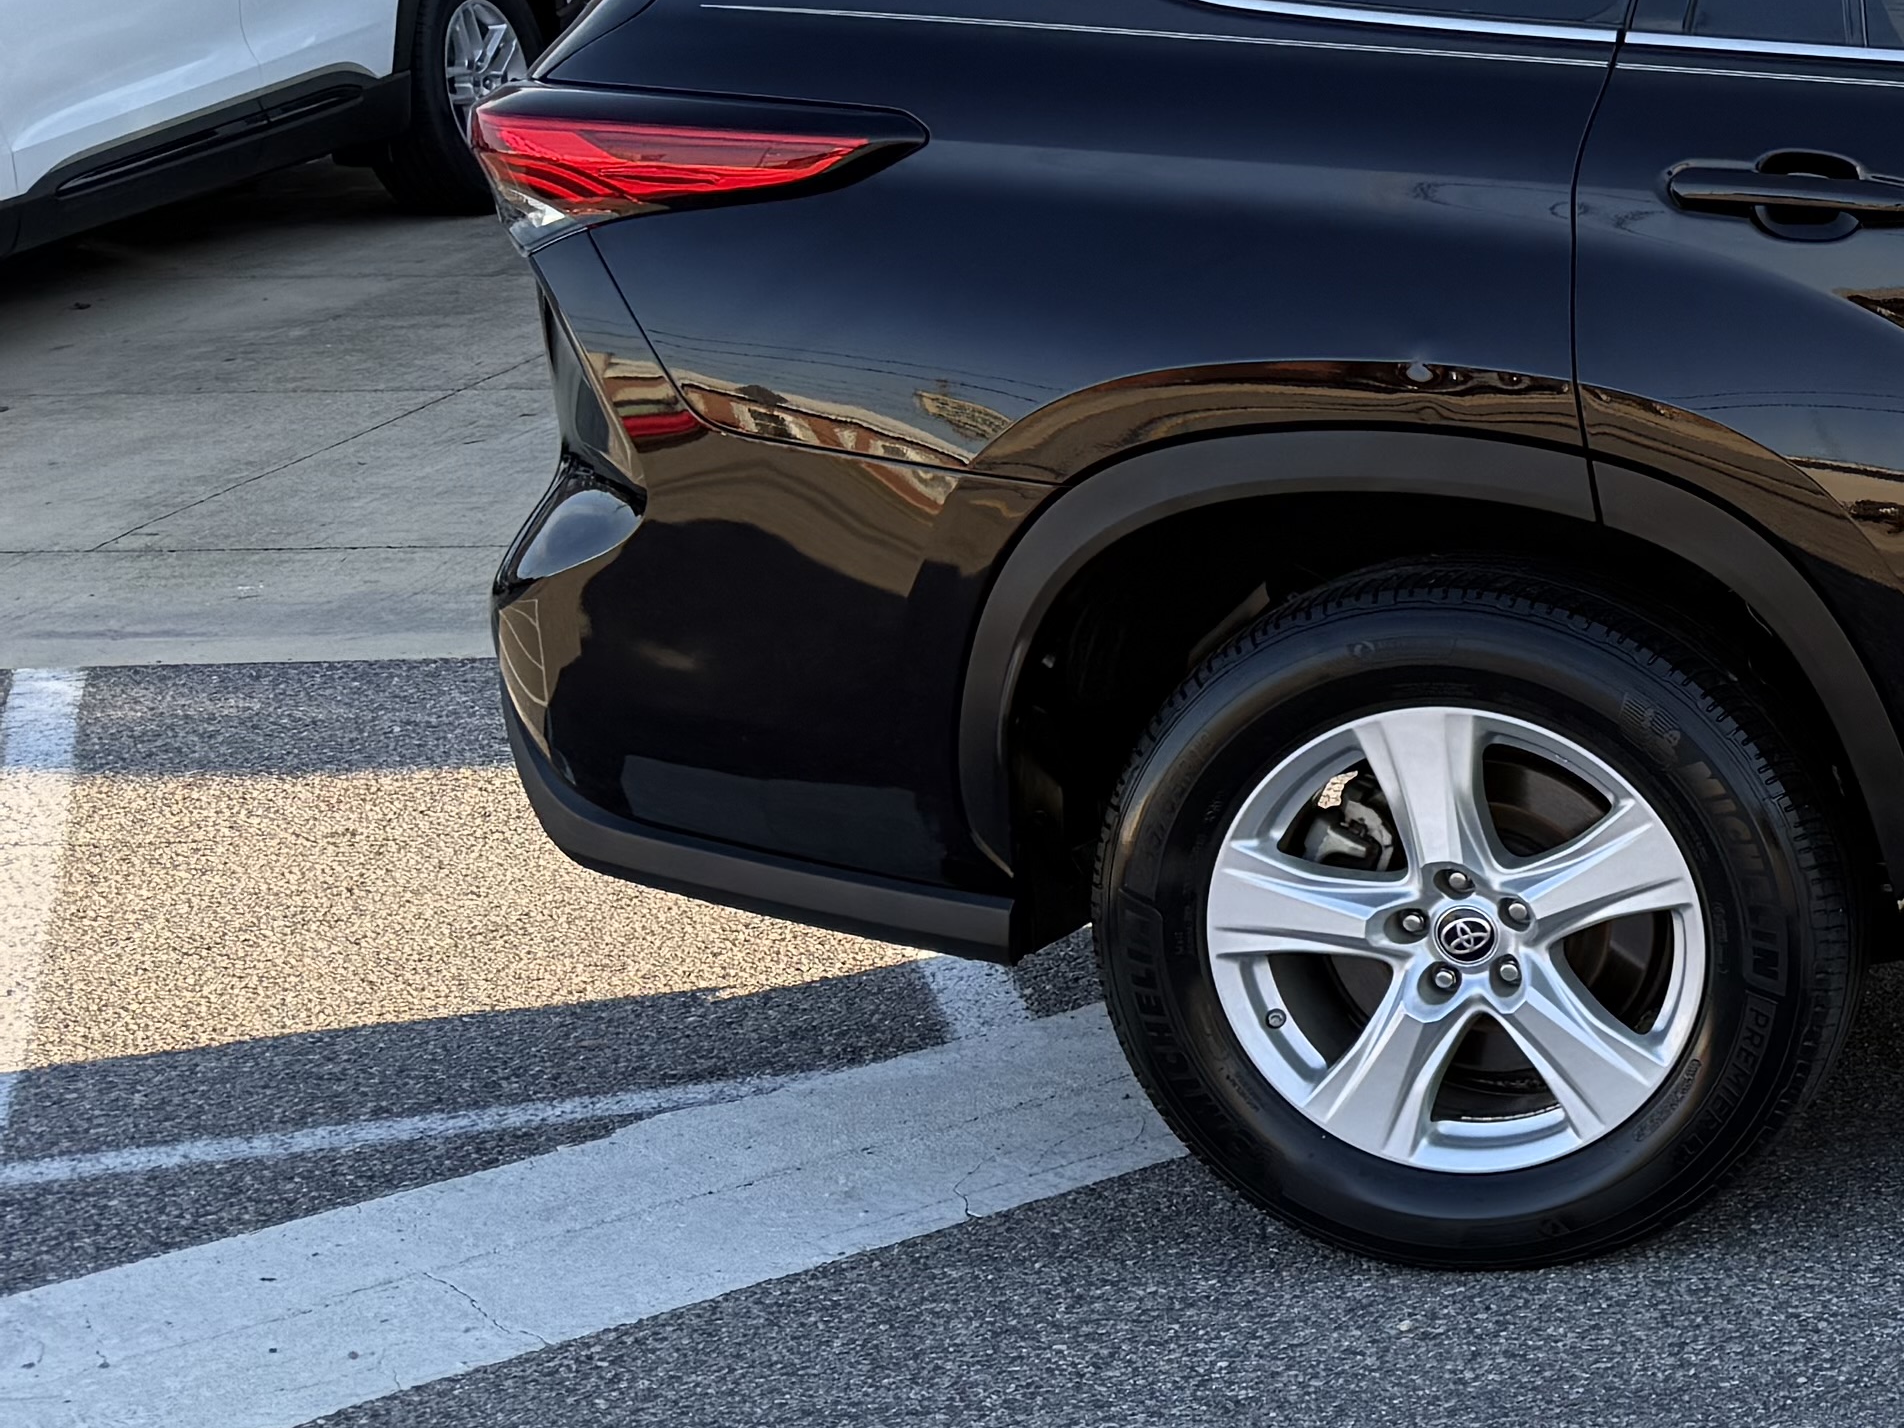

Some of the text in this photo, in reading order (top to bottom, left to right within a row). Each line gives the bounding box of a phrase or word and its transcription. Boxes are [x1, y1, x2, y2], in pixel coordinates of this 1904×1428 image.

[1676, 760, 1780, 981] MICHELIN
[1122, 911, 1232, 1136] MICHELIN
[1699, 1008, 1770, 1132] PREMIER
